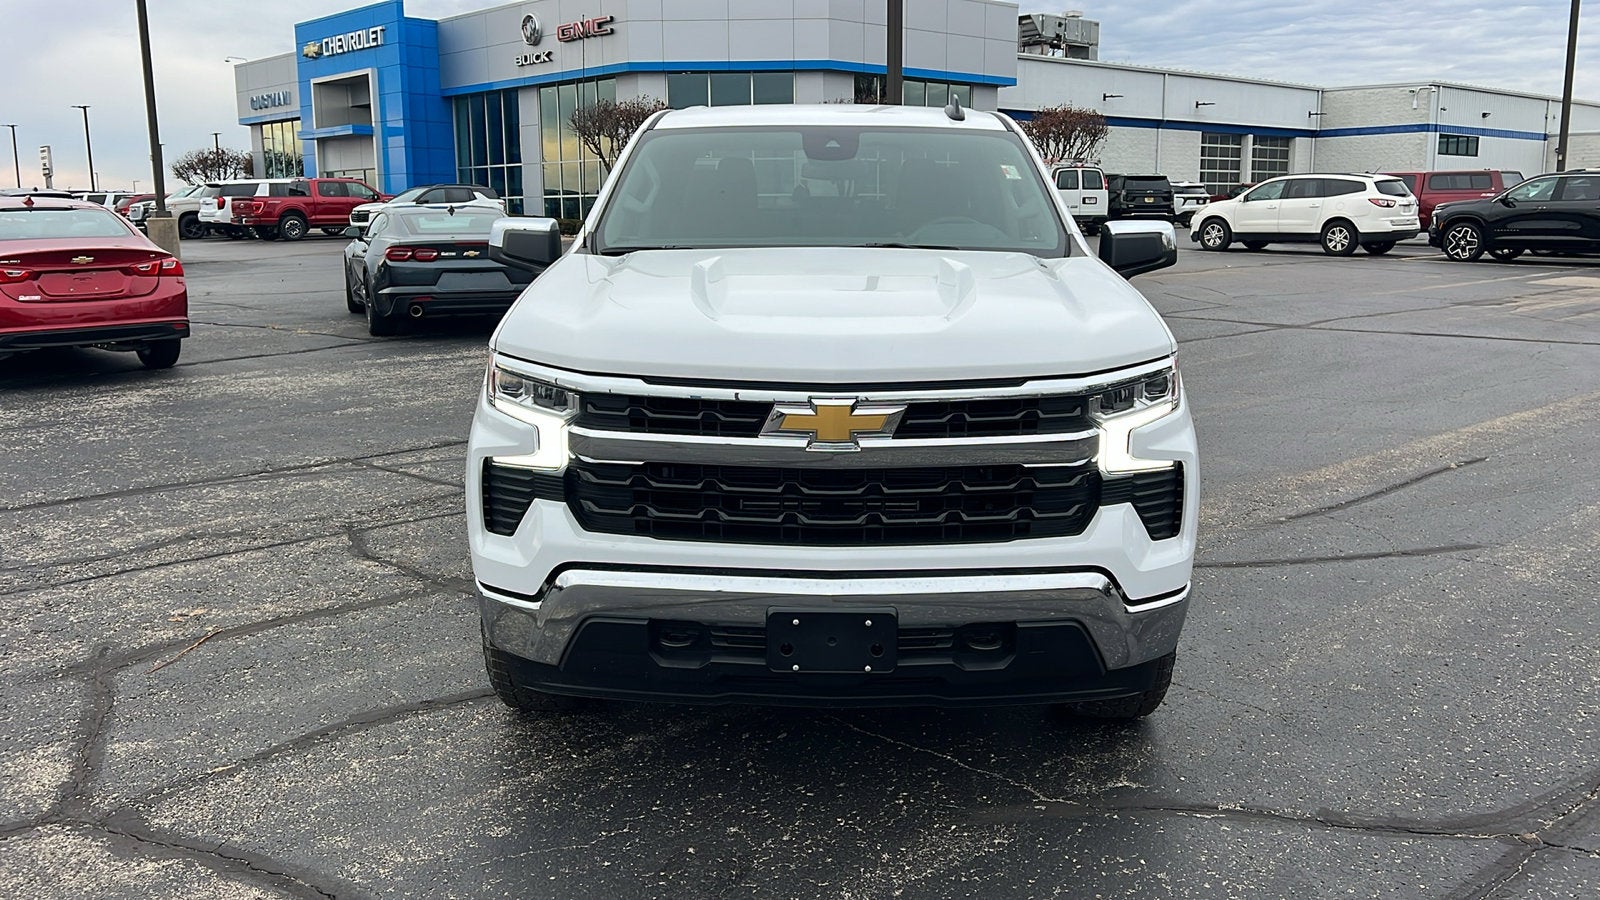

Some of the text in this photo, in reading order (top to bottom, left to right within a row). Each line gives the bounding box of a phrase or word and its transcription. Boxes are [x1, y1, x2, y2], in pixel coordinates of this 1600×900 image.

[322, 25, 385, 56] CHEVROLET
[556, 15, 614, 42] GMC
[515, 50, 553, 66] BUICK
